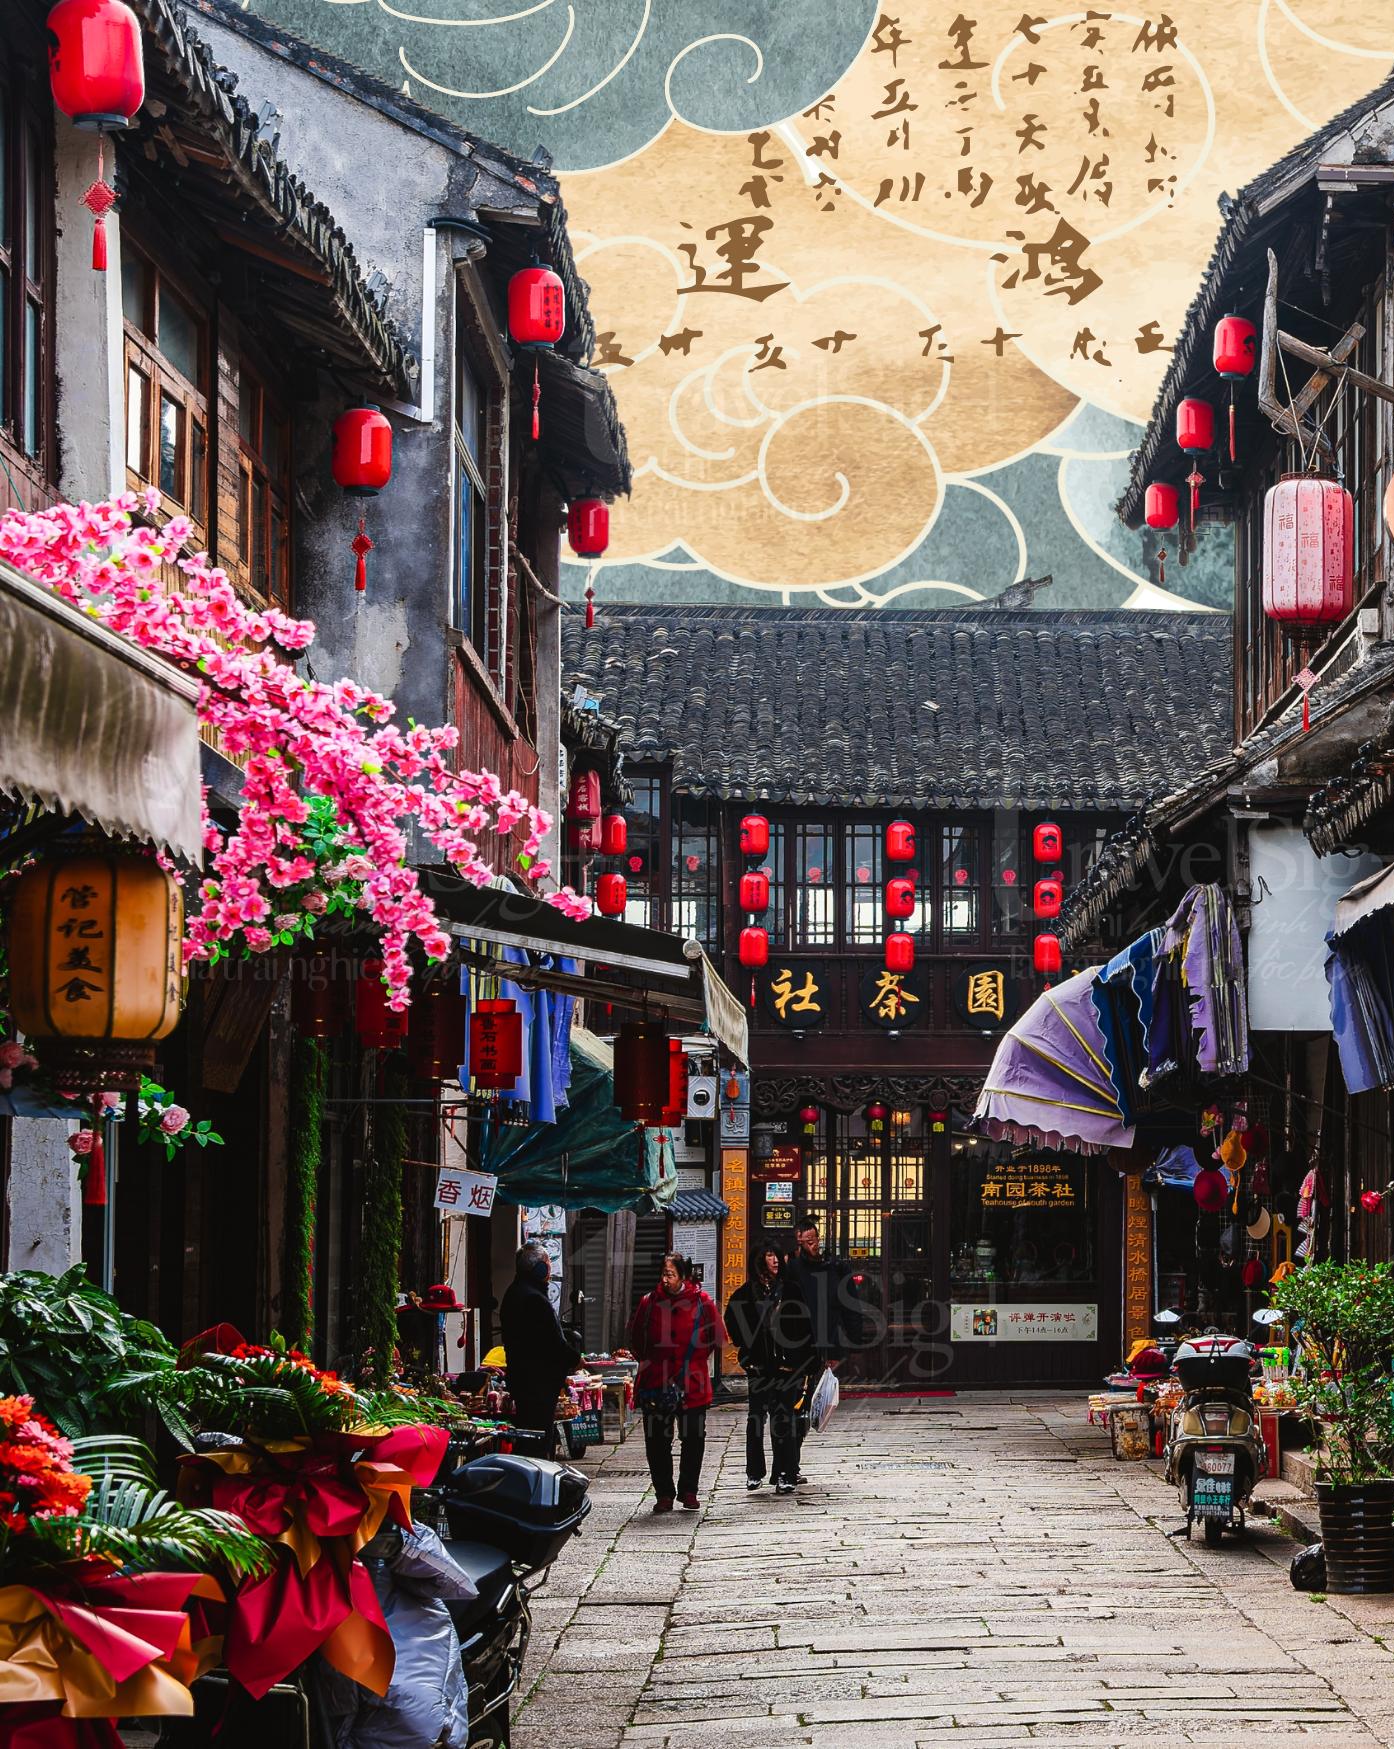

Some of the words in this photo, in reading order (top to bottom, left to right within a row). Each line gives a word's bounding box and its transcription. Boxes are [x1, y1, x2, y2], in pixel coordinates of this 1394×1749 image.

[438, 1179, 494, 1209] 香烟
[981, 1182, 1075, 1198] 南园茶社
[982, 1199, 1017, 1207] Teahouse
[1048, 1199, 1074, 1208] garden
